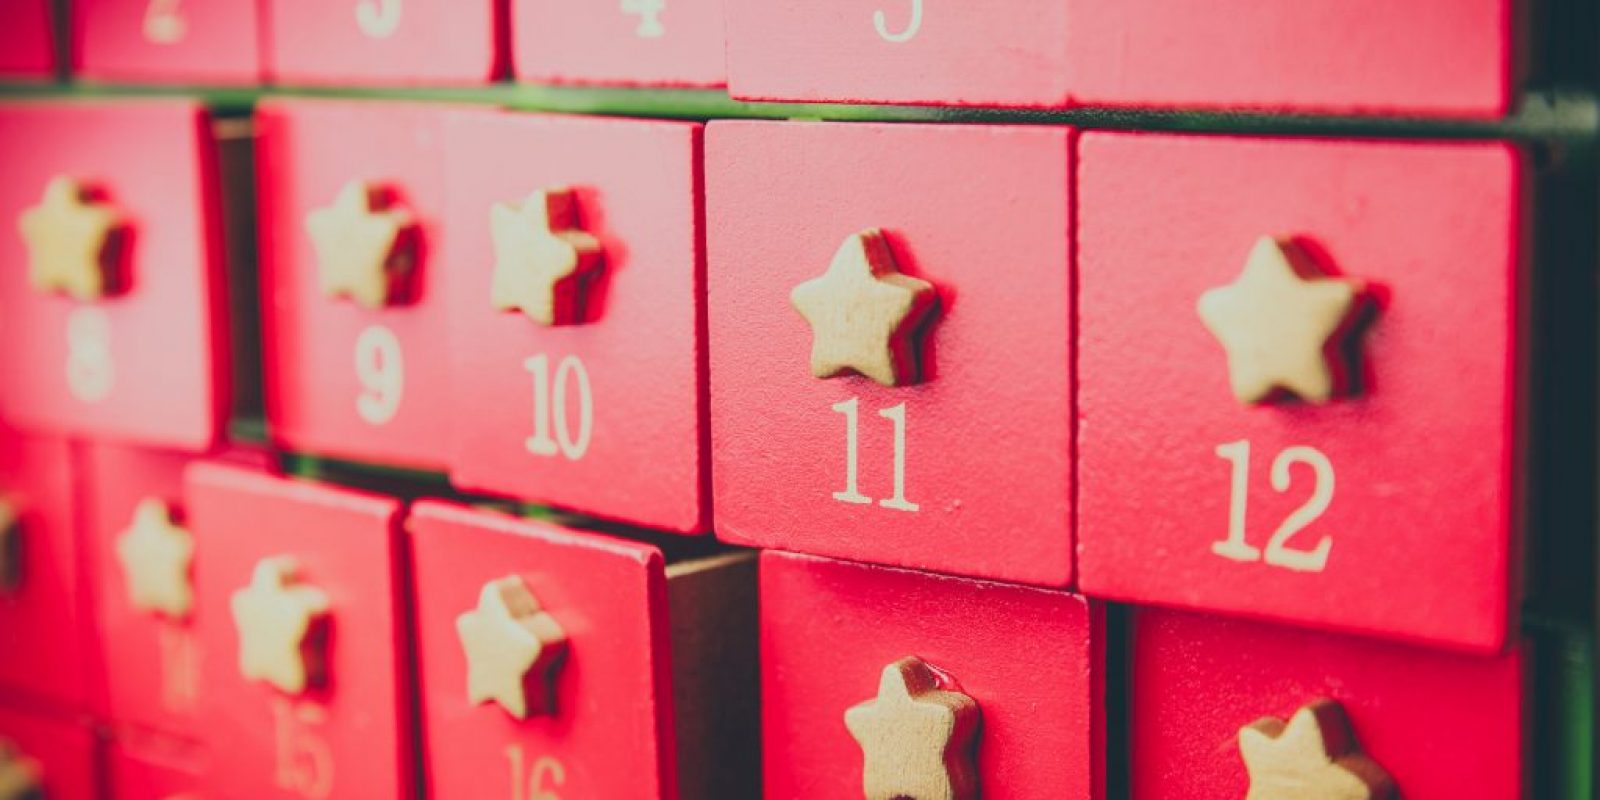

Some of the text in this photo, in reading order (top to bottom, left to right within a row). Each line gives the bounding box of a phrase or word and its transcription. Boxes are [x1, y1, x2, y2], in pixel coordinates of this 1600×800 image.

[355, 326, 403, 424] 9
[524, 354, 592, 459] 10
[832, 397, 919, 511] 11
[1211, 440, 1335, 571] 12
